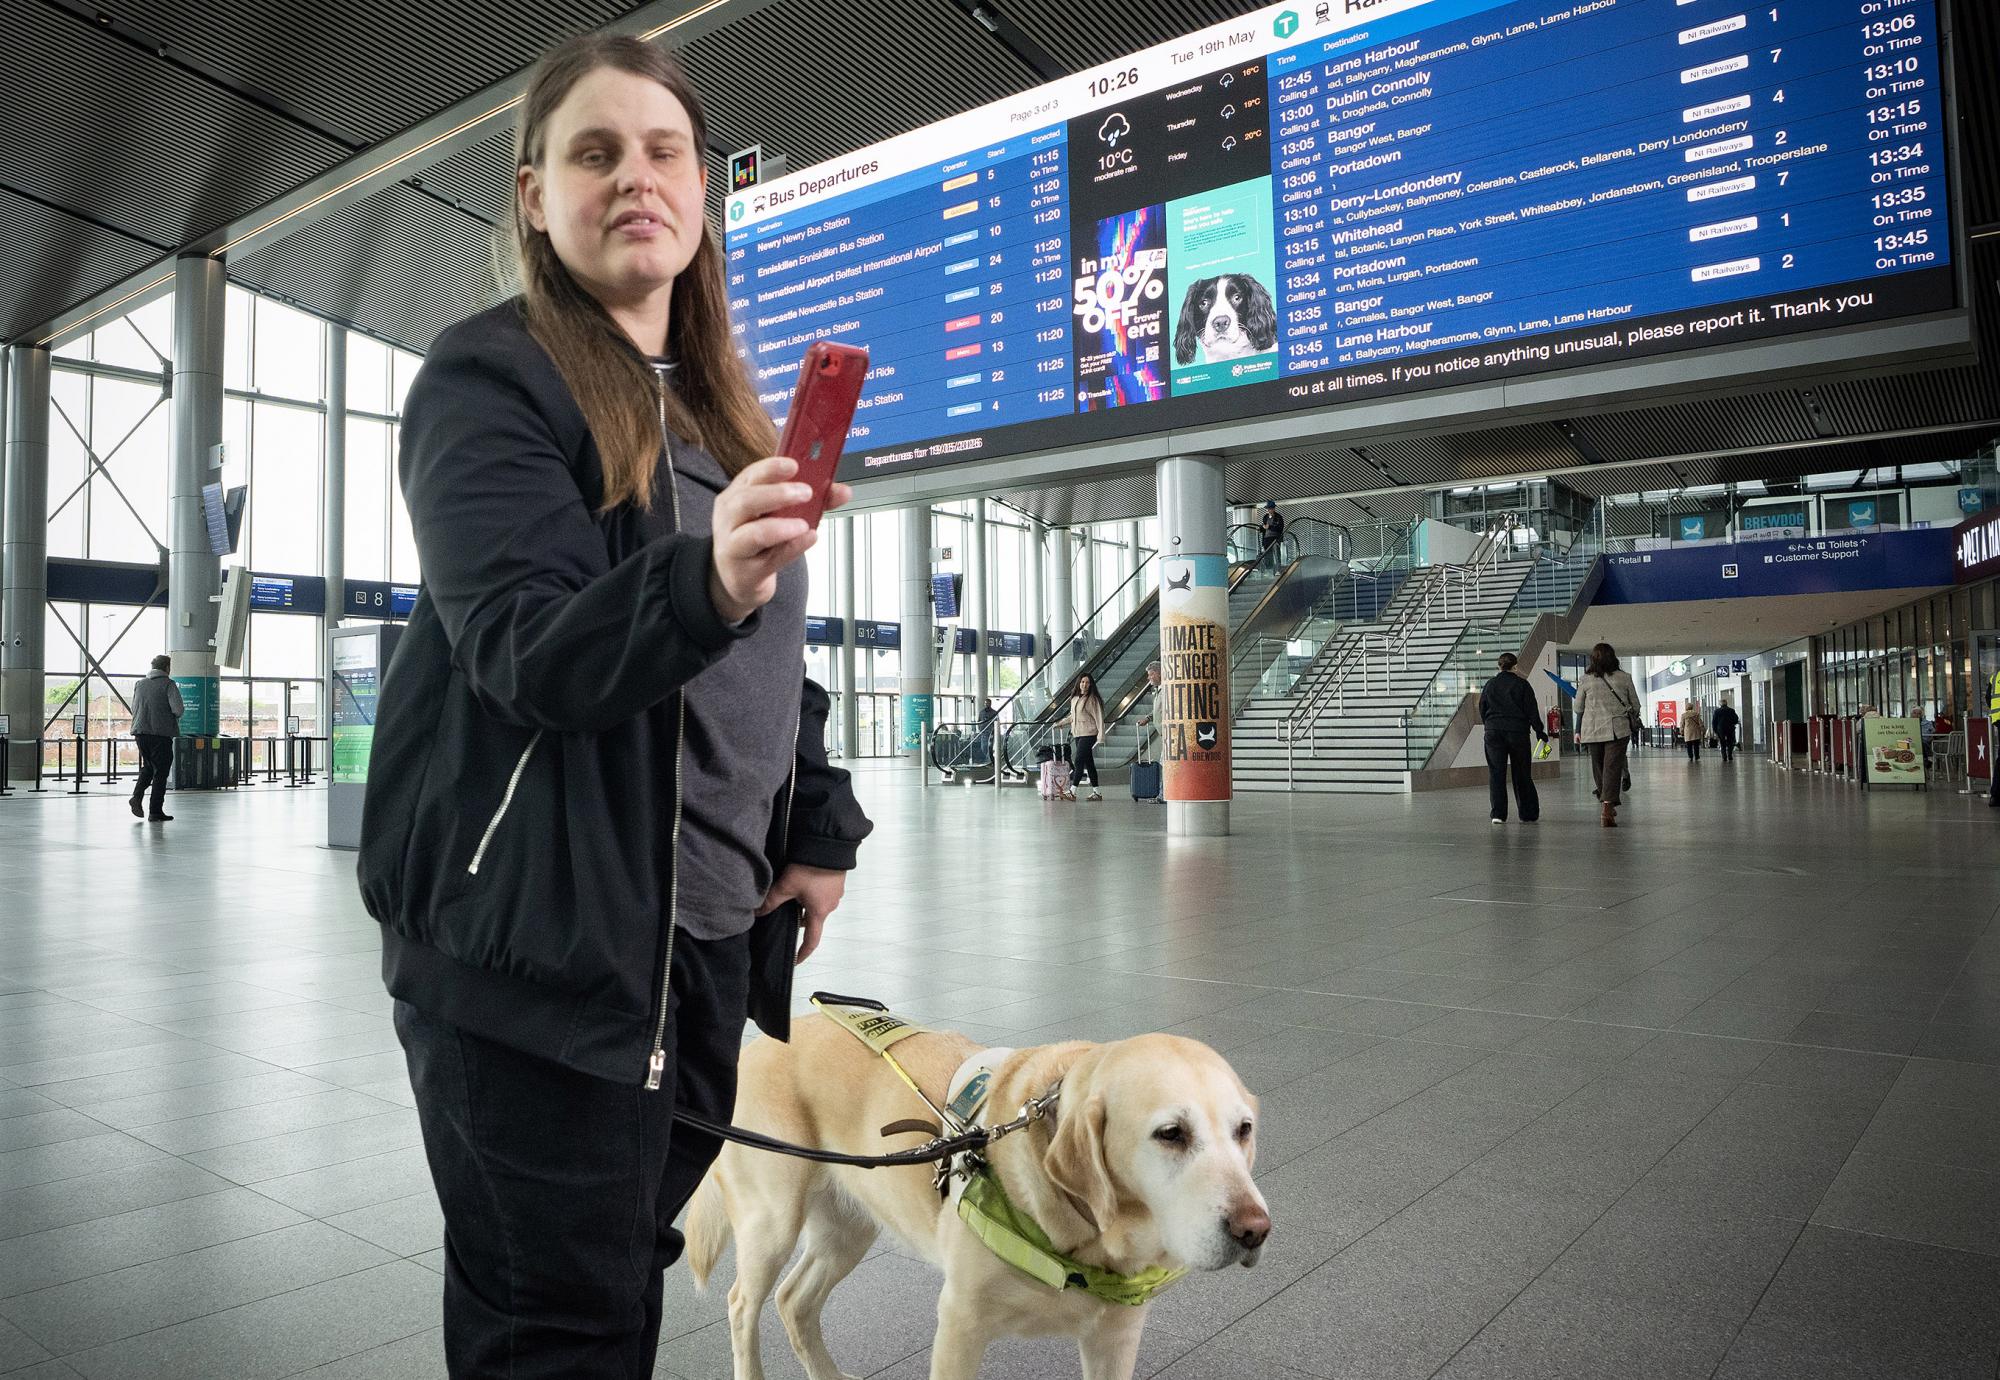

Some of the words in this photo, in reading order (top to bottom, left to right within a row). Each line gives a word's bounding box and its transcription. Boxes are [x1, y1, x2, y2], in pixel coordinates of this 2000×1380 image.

[1688, 32, 1697, 40] NI
[1699, 21, 1737, 37] Railways
[1277, 55, 1296, 66] Time
[1324, 32, 1369, 52] Destination
[1346, 64, 1393, 85] Ballycarry,
[1395, 41, 1469, 69] Magheramorne,
[1472, 31, 1503, 47] Glynn,
[1506, 20, 1538, 36] Larne,
[1540, 11, 1570, 26] Larne
[1089, 67, 1139, 98] 10:26
[1171, 53, 1194, 66] Tue
[1199, 40, 1225, 56] 19th
[1229, 31, 1256, 48] May
[1279, 71, 1312, 90] 12:45
[1325, 60, 1361, 77] Larne
[1365, 39, 1420, 65] Harbour
[1166, 84, 1203, 101] Wednesday
[1280, 104, 1314, 123] 13:00
[1326, 88, 1368, 110] Dublin
[1372, 71, 1431, 97] Connolly
[1773, 90, 1784, 104] 4
[1866, 87, 1886, 100] On
[1890, 78, 1925, 94] Time
[1010, 109, 1032, 123] Page
[1034, 106, 1040, 114] 3
[1043, 102, 1051, 113] of
[1053, 99, 1059, 110] 3
[1167, 118, 1196, 132] Thursday
[1280, 123, 1309, 137] Calling
[1311, 119, 1320, 128] at
[943, 160, 968, 174] Operator
[987, 148, 1006, 158] Stand
[1032, 130, 1061, 145] Expected
[1281, 138, 1315, 156] 13:05
[1328, 122, 1376, 144] Bangor
[1030, 169, 1041, 179] On
[1042, 165, 1059, 176] Time
[1098, 148, 1133, 172] 10°C
[1168, 152, 1188, 163] Friday
[1282, 171, 1317, 190] 13:06
[1329, 150, 1402, 177] Portadown
[1346, 202, 1404, 223] Cullybackey,
[1406, 188, 1464, 209] Ballymoney,
[1466, 175, 1517, 193] Coleraine,
[1520, 160, 1579, 181] Castlerock,
[1582, 147, 1636, 166] Bellarena,
[1638, 135, 1670, 154] Derry
[1673, 119, 1748, 145] Londonderry
[770, 189, 794, 206] Bus
[800, 159, 879, 197] Departures
[1094, 170, 1124, 182] moderate
[1125, 165, 1138, 174] rain
[758, 238, 782, 253] Newry
[783, 231, 806, 245] Newry
[807, 225, 822, 237] Bus
[823, 216, 850, 232] Station
[988, 170, 994, 180] 5
[1033, 150, 1059, 166] 11:15
[1284, 205, 1318, 223] 13:10
[1331, 170, 1462, 212] Derry~Londonderry
[1351, 241, 1388, 256] Botanic,
[1390, 233, 1425, 249] Lanyon
[1427, 226, 1456, 240] Place,
[1459, 219, 1482, 232] York
[1485, 211, 1518, 226] Street,
[1520, 198, 1586, 219] Whiteabbey,
[1589, 179, 1664, 204] Jordanstown,
[1668, 161, 1741, 187] Greenisland,
[1744, 142, 1828, 169] Trooperslane
[758, 260, 798, 278] Enniskillen
[800, 247, 838, 264] Enniskillen
[840, 242, 854, 254] Bus
[856, 233, 884, 248] Station
[989, 197, 1000, 208] 15
[1033, 180, 1060, 195] 11:20
[1285, 238, 1319, 256] 13:15
[1332, 219, 1403, 246] Whitehead
[1874, 229, 1928, 252] 13:45
[758, 283, 806, 303] International
[806, 272, 834, 290] Airport
[835, 265, 862, 280] Belfast
[863, 250, 913, 273] International
[914, 243, 942, 260] Airport
[990, 226, 1002, 237] 10
[1034, 209, 1060, 224] 11:20
[1081, 258, 1098, 275] in
[1101, 252, 1128, 272] my
[1875, 258, 1896, 270] On
[1900, 250, 1935, 265] Time
[1287, 272, 1320, 290] 13:34
[1334, 255, 1406, 280] Portadown
[1073, 264, 1164, 316] 50%
[1288, 306, 1322, 324] 13:35
[1335, 295, 1384, 314] Bangor
[1127, 321, 1160, 340] era
[1288, 339, 1323, 357] 13:45
[1336, 334, 1374, 349] Larne
[1377, 321, 1433, 342] Harbour
[1312, 380, 1325, 393] at
[1328, 377, 1344, 390] all
[1347, 372, 1388, 393] times.
[1392, 368, 1402, 381] If
[1404, 362, 1431, 382] you
[1435, 355, 1480, 374] notice
[1484, 345, 1550, 369] anything
[1554, 332, 1623, 355] unusual,
[1628, 323, 1685, 346] please
[1690, 313, 1744, 334] report
[1749, 309, 1765, 324] it.
[1770, 299, 1831, 320] Thank
[1836, 293, 1873, 313] you
[758, 364, 799, 380] Sydenham
[876, 367, 895, 378] Ride
[992, 341, 1004, 352] 13
[1088, 389, 1112, 398] Translink
[1744, 513, 1805, 530] BREWDOG
[1829, 540, 1858, 549] Toilets
[1982, 525, 1988, 561] A
[1618, 556, 1642, 565] Retail
[1775, 553, 1820, 563] Customer
[1821, 550, 1859, 560] Support
[374, 592, 383, 606] 8
[866, 628, 876, 639] 12
[995, 638, 1003, 648] 14
